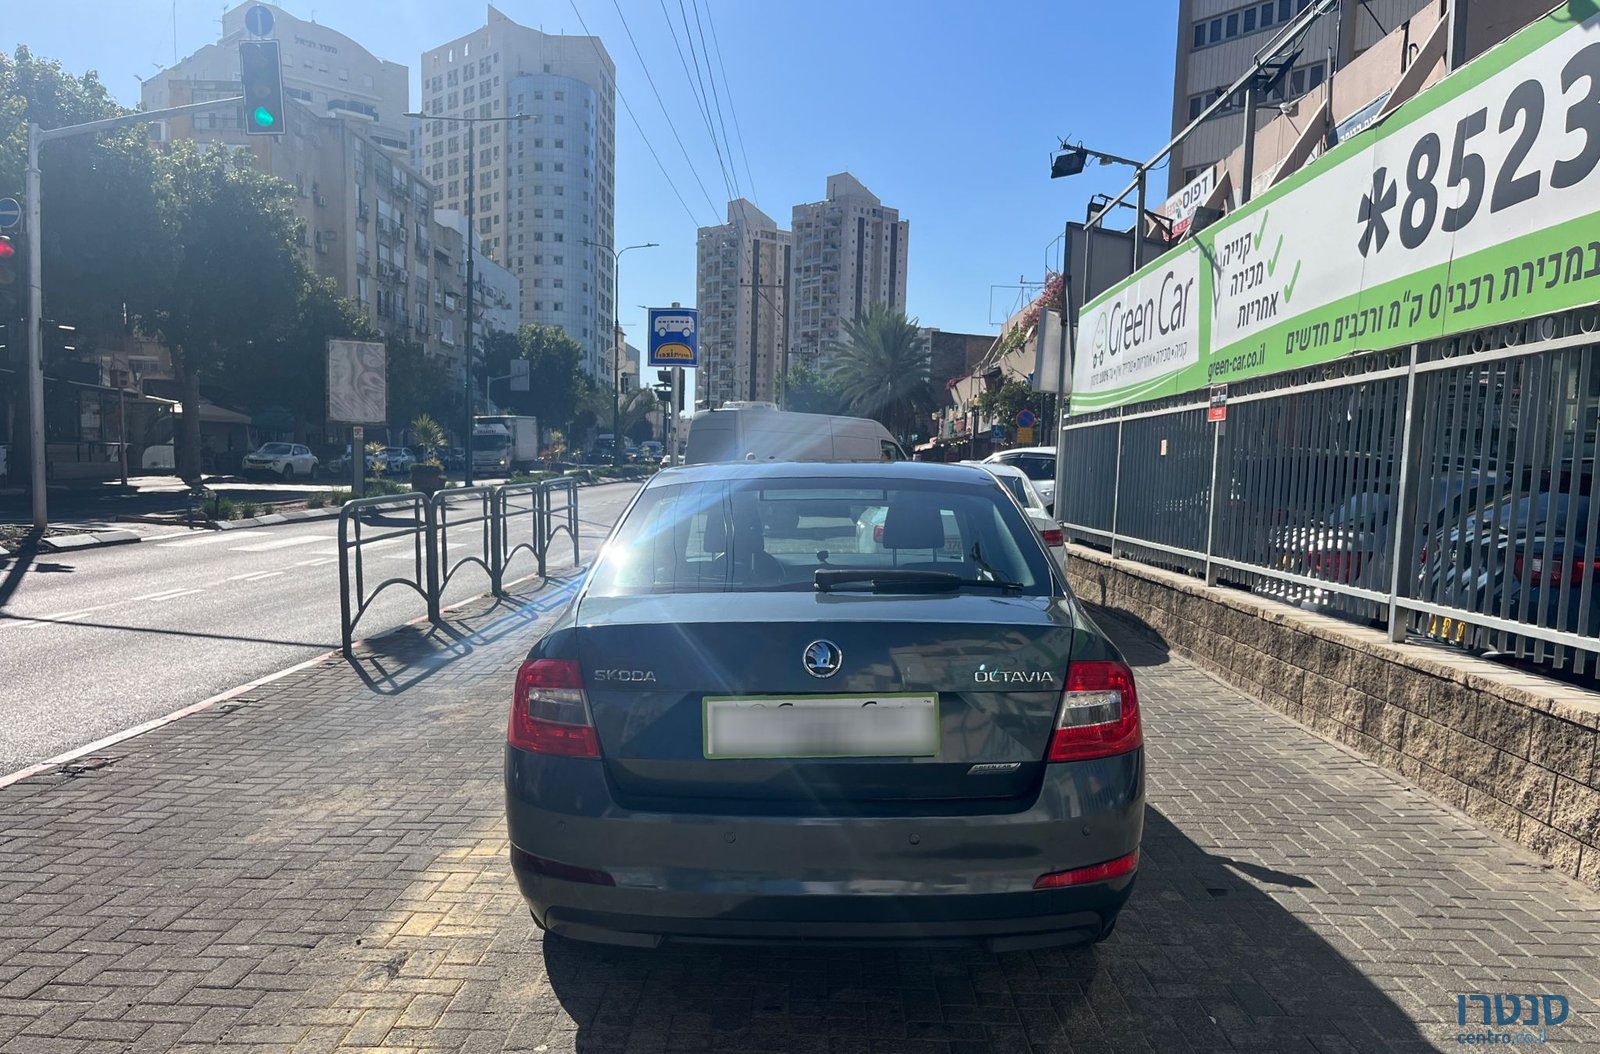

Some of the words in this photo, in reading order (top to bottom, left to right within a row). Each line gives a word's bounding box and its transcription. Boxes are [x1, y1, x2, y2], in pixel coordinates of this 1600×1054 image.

[1182, 176, 1208, 209] דפוס
[1222, 232, 1252, 267] קנייה
[1230, 261, 1264, 297] מכירה
[1500, 241, 1600, 302] במכירת
[1237, 291, 1279, 329] אחריות
[1428, 283, 1441, 320] 0
[1447, 273, 1495, 314] רכבי
[1108, 298, 1154, 356] Green
[1158, 270, 1194, 336] Car
[1333, 305, 1384, 343] ורכבים
[1285, 321, 1330, 355] חדשים
[1207, 342, 1266, 383] green-car.co.il
[974, 671, 1054, 683] OCTAVIA
